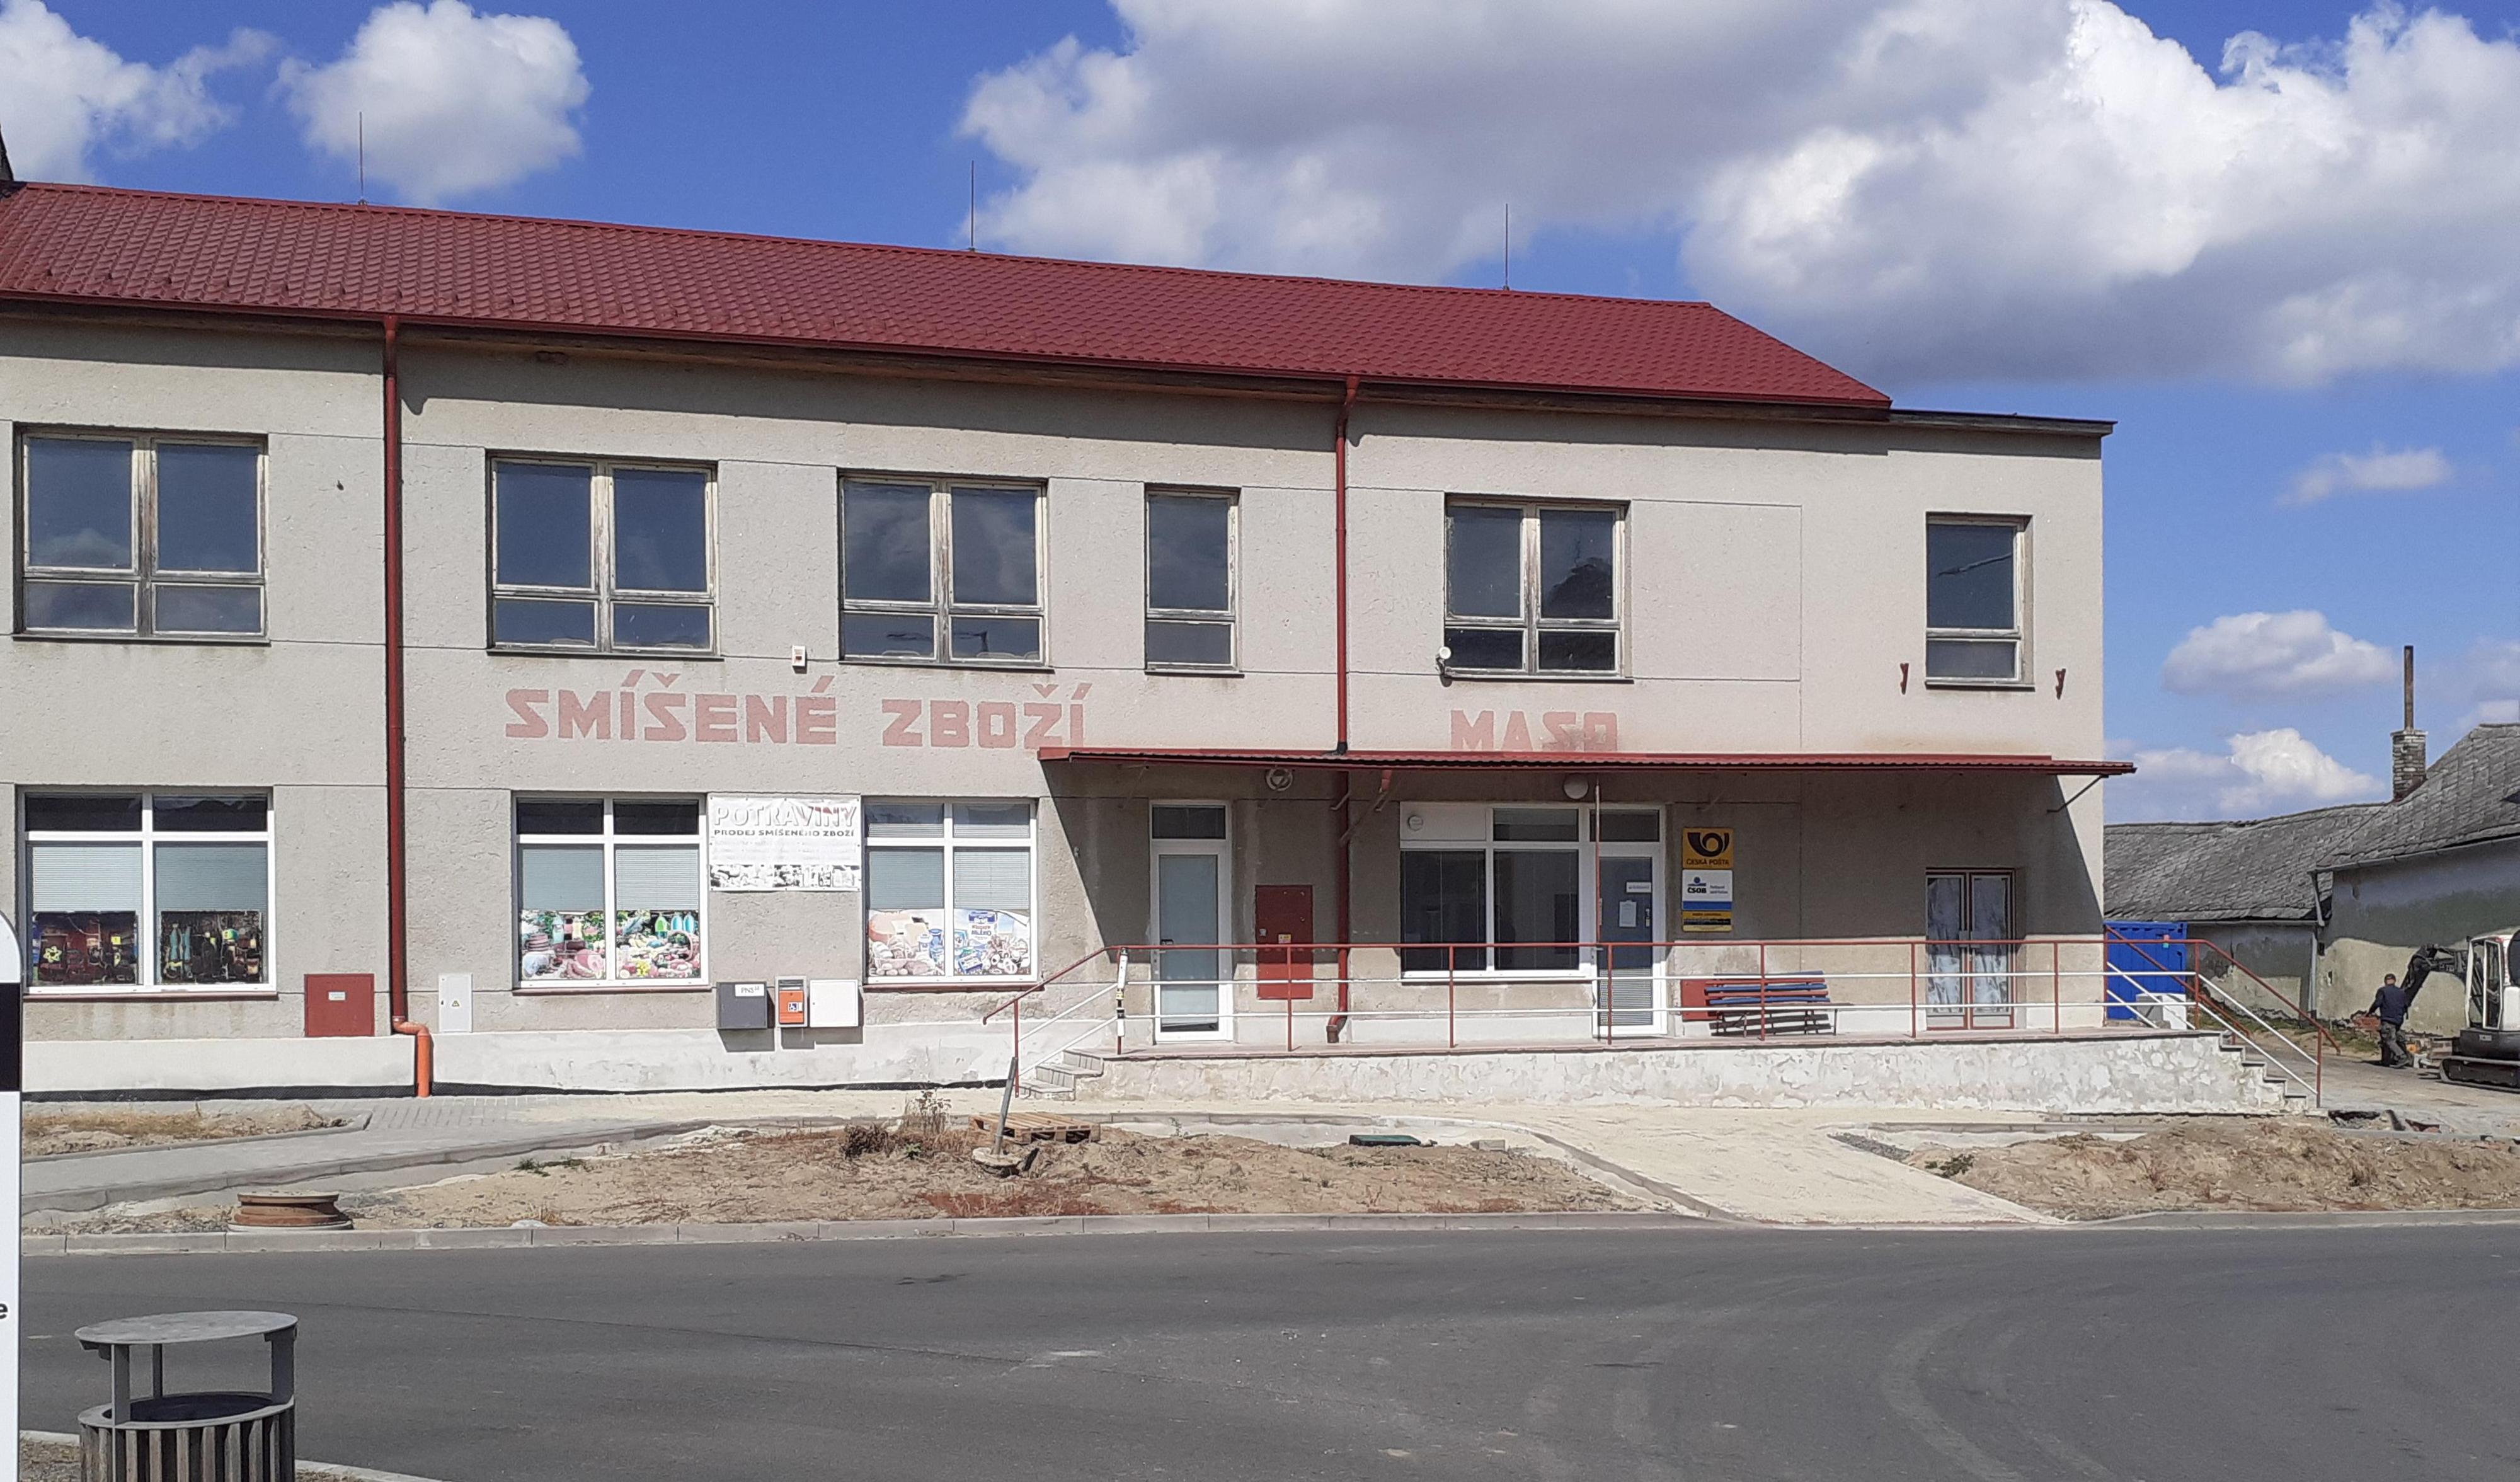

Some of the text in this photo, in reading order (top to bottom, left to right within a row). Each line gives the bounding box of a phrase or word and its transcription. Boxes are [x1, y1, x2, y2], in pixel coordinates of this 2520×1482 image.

[505, 669, 1092, 749] SMÍŠENÉ ZBOŽÍ
[1450, 709, 1617, 752] MASO
[714, 805, 857, 827] POTRAVINY
[823, 829, 854, 837] ZBOŽÍ
